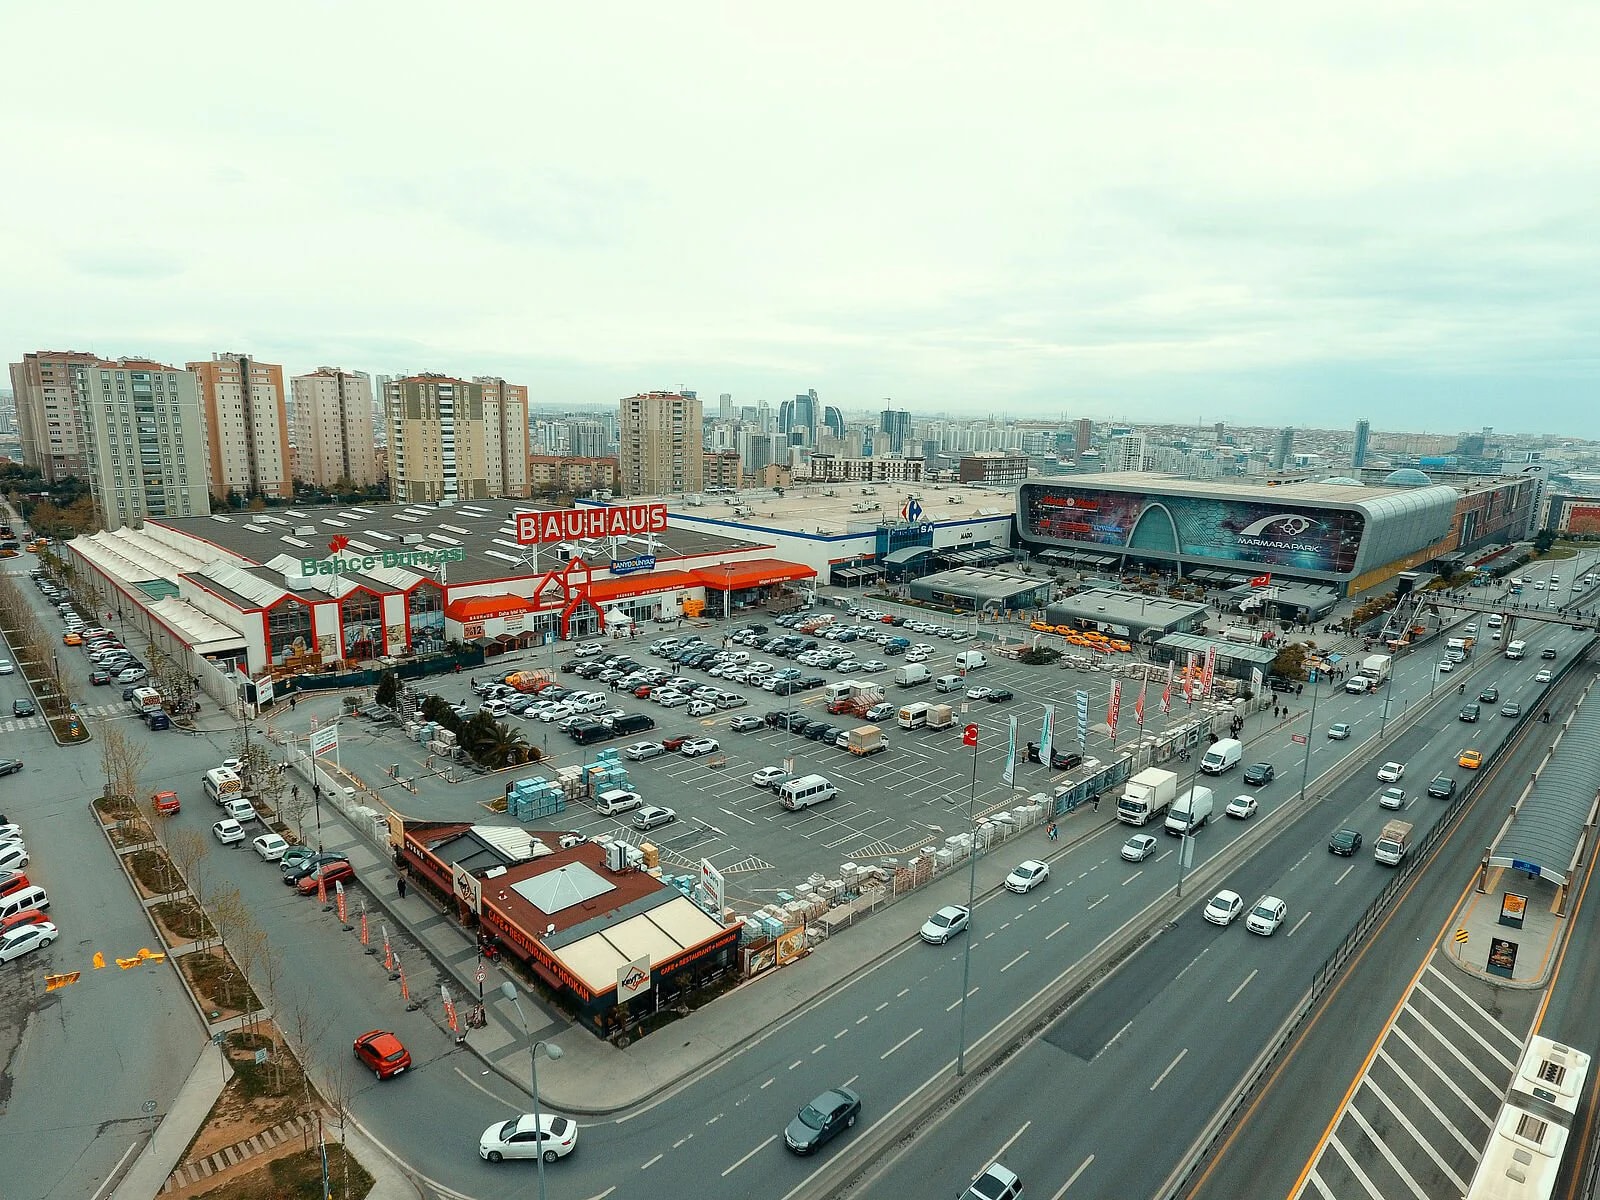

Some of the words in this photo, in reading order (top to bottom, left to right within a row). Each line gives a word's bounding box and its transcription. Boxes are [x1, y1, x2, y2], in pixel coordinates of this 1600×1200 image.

[519, 508, 666, 541] BAUHAUS
[488, 910, 505, 930] CAFE
[509, 927, 552, 970] RESTAURANT
[558, 967, 590, 1003] HOOKAH
[678, 945, 712, 967] RESTAURANT
[715, 933, 737, 949] HOOKAH
